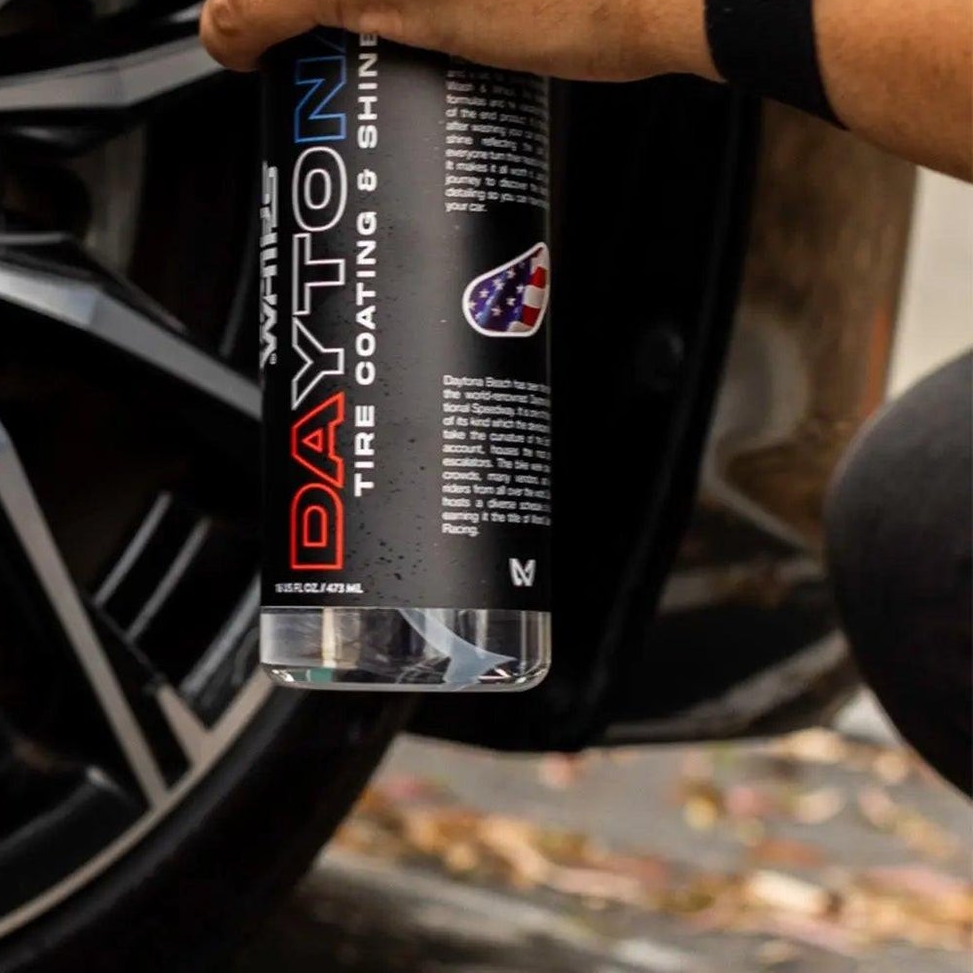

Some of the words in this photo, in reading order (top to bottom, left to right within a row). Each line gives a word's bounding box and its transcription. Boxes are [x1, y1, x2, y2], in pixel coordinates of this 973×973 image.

[357, 33, 378, 149] SHINE
[357, 168, 377, 192] &
[355, 211, 377, 386] COATING
[442, 375, 484, 387] Daytona
[354, 405, 376, 497] TIRE
